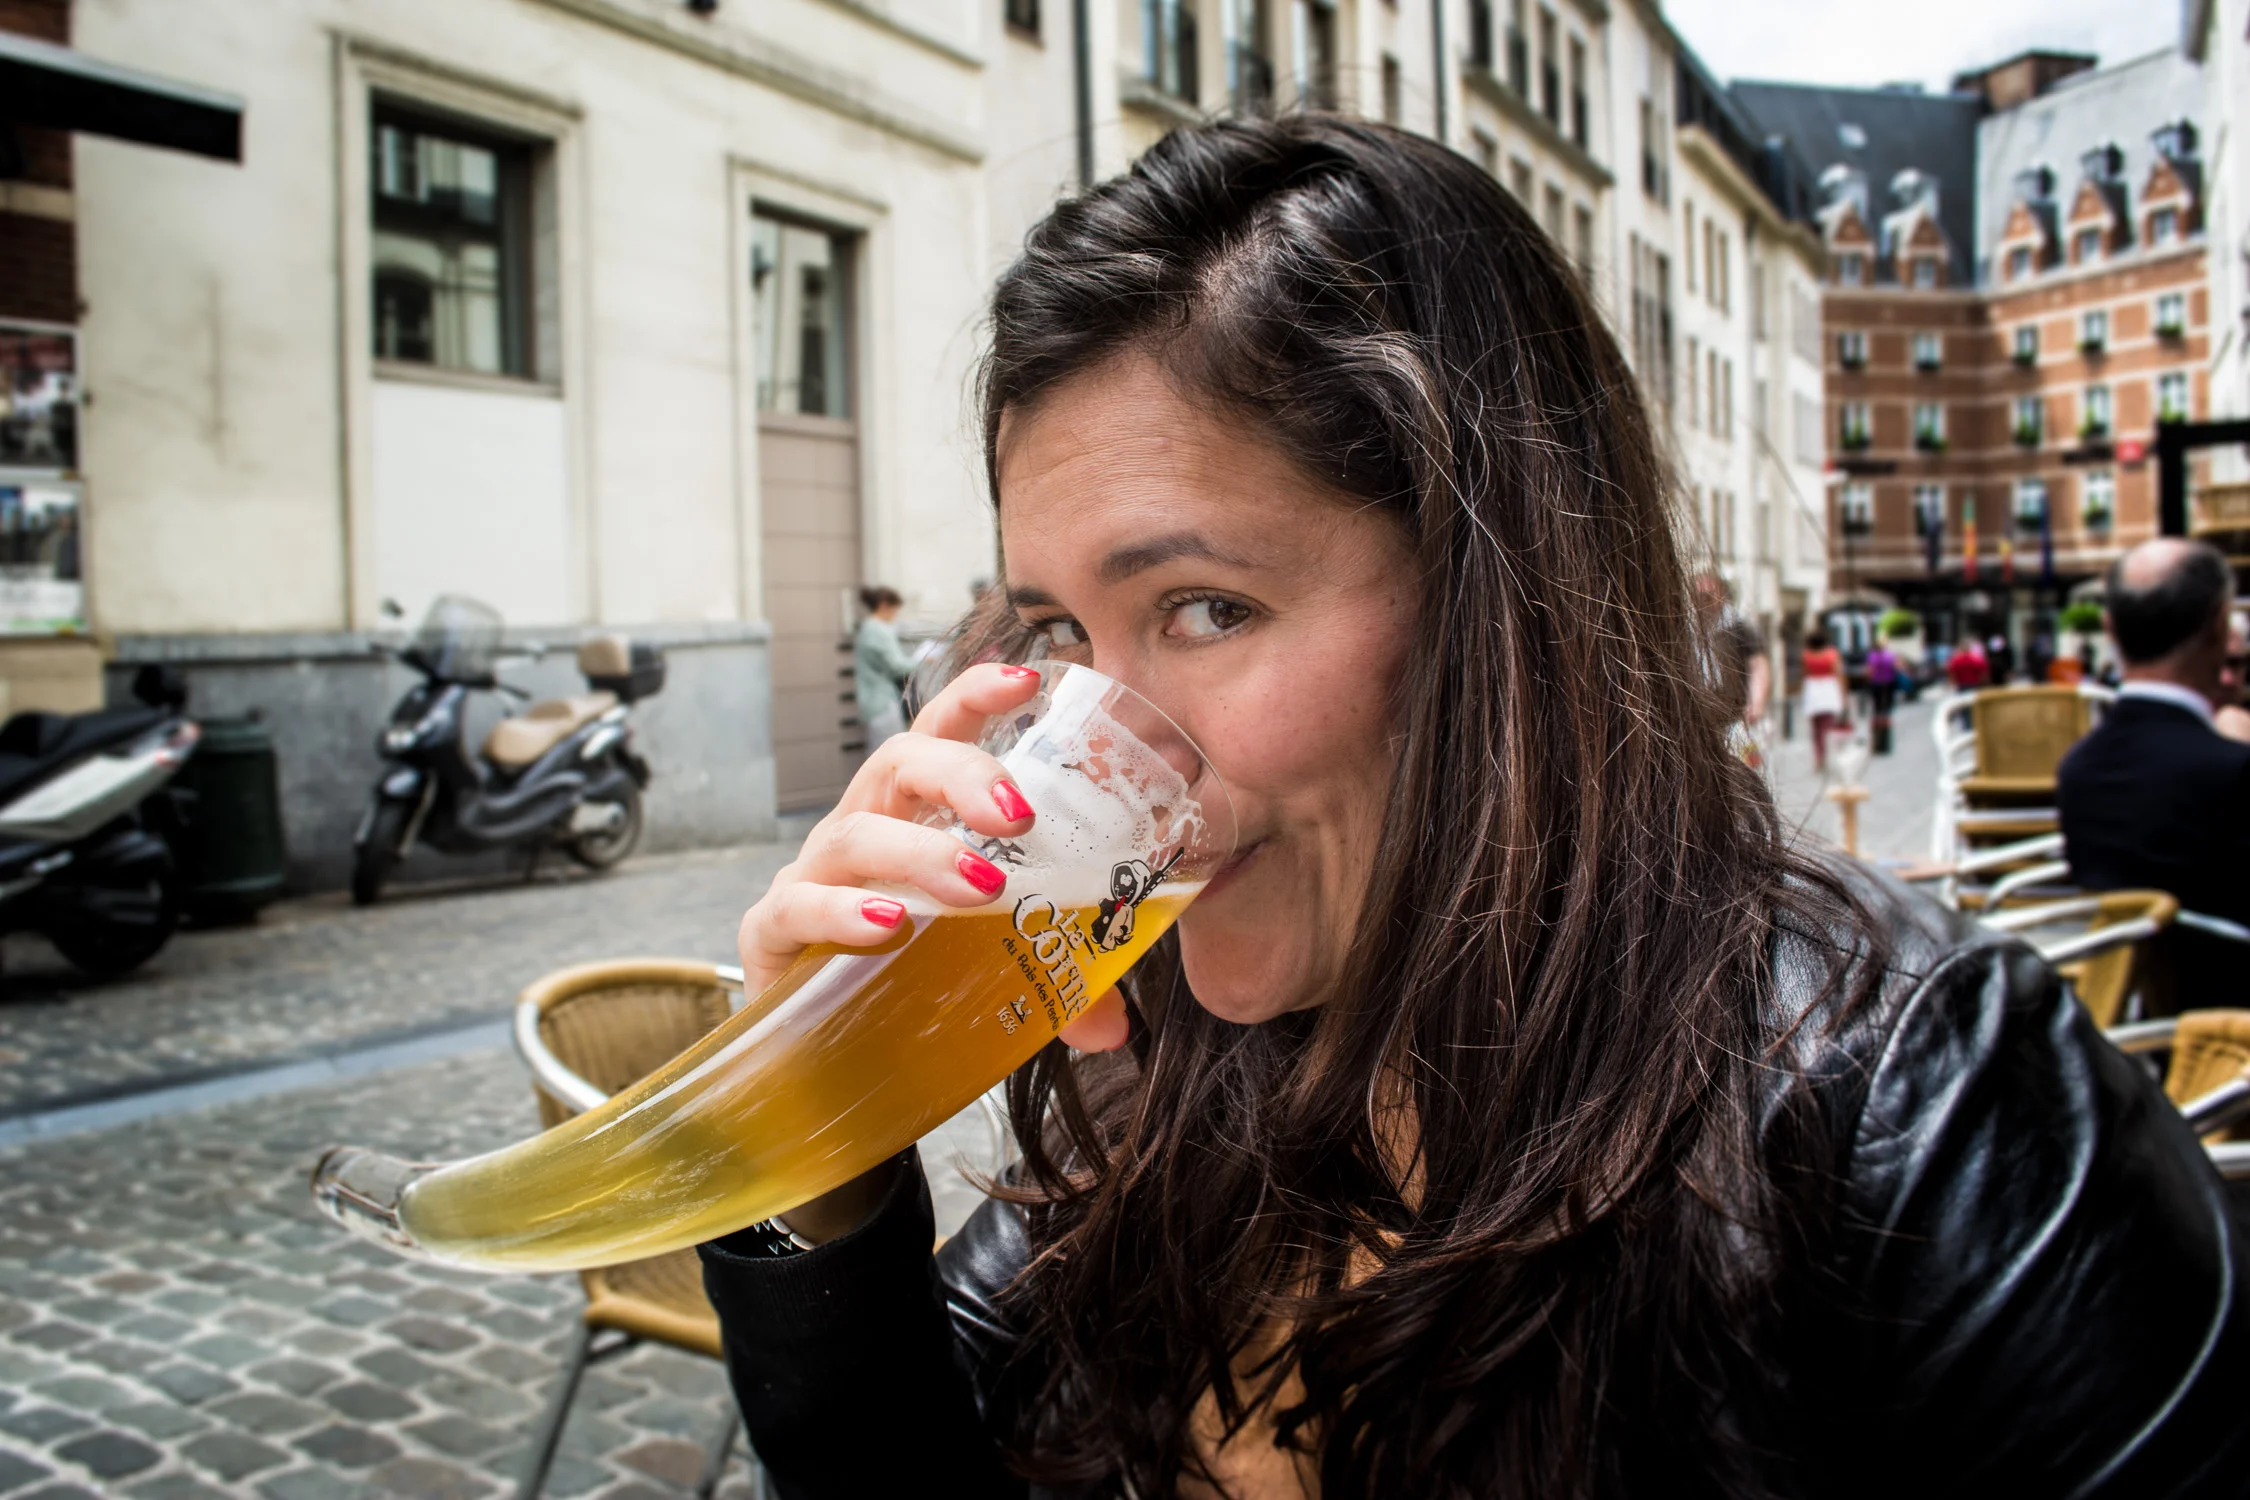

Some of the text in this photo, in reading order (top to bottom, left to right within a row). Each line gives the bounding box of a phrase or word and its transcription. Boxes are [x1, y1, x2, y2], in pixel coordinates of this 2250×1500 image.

[1057, 909, 1085, 951] La
[1002, 937, 1018, 956] du
[1017, 953, 1037, 982] Bois
[1034, 982, 1049, 1002] des
[1012, 893, 1091, 1022] Corne
[996, 1006, 1019, 1035] 1636
